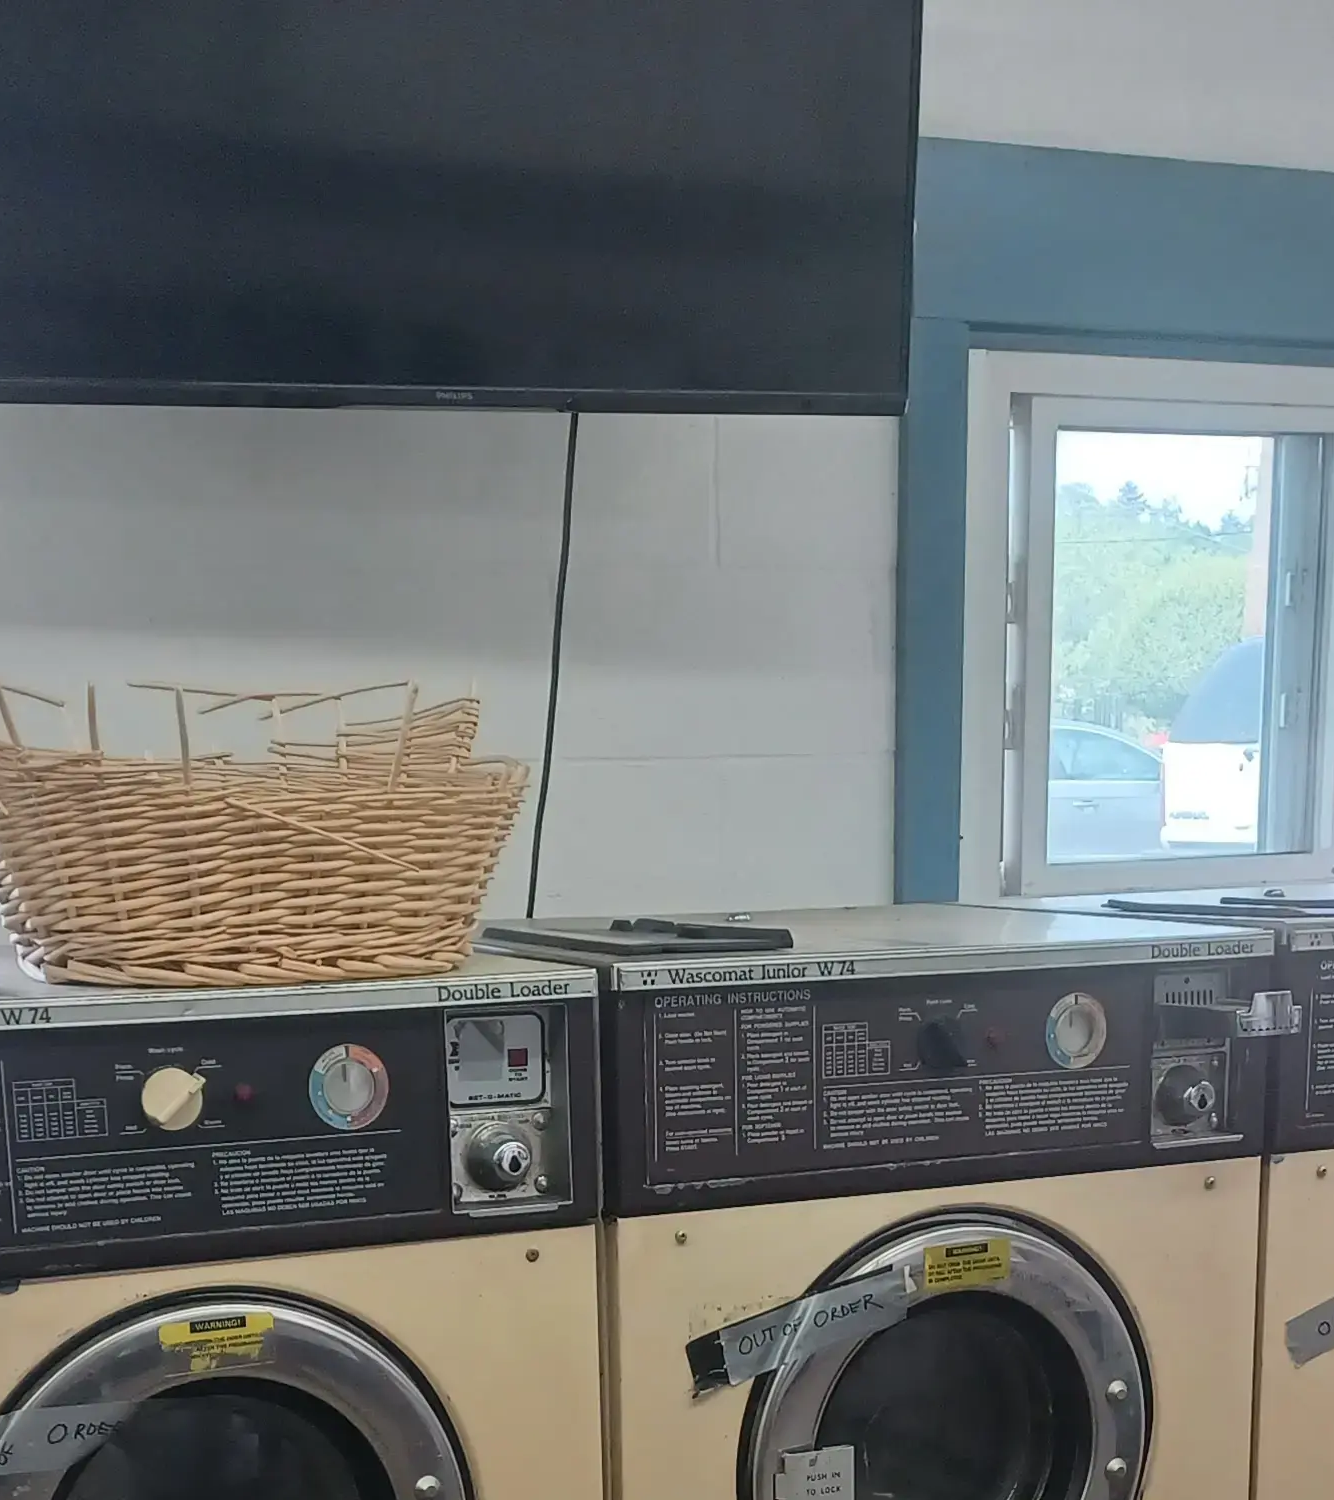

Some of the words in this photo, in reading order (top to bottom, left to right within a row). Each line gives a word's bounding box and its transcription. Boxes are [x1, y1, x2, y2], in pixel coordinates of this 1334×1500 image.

[436, 391, 473, 400] PHILIPS
[1151, 942, 1201, 959] Double
[1207, 940, 1254, 956] Loader
[668, 967, 754, 985] Wascomat
[761, 964, 808, 981] Junior
[817, 961, 835, 976] W
[838, 960, 856, 975] 74
[437, 983, 501, 1002] Double
[509, 980, 570, 999] Loader
[655, 993, 722, 1009] OPERATING
[727, 988, 811, 1005] INSTRUCTIONS
[0, 1009, 22, 1026] W
[27, 1007, 52, 1024] 74
[194, 1318, 242, 1331] WARNING!
[738, 1326, 777, 1355] OUT
[782, 1316, 802, 1337] OF
[813, 1293, 885, 1328] ORDER
[806, 1472, 828, 1483] PUSH
[831, 1470, 841, 1479] IN
[806, 1487, 817, 1497] TO
[820, 1485, 841, 1495] LOCK
